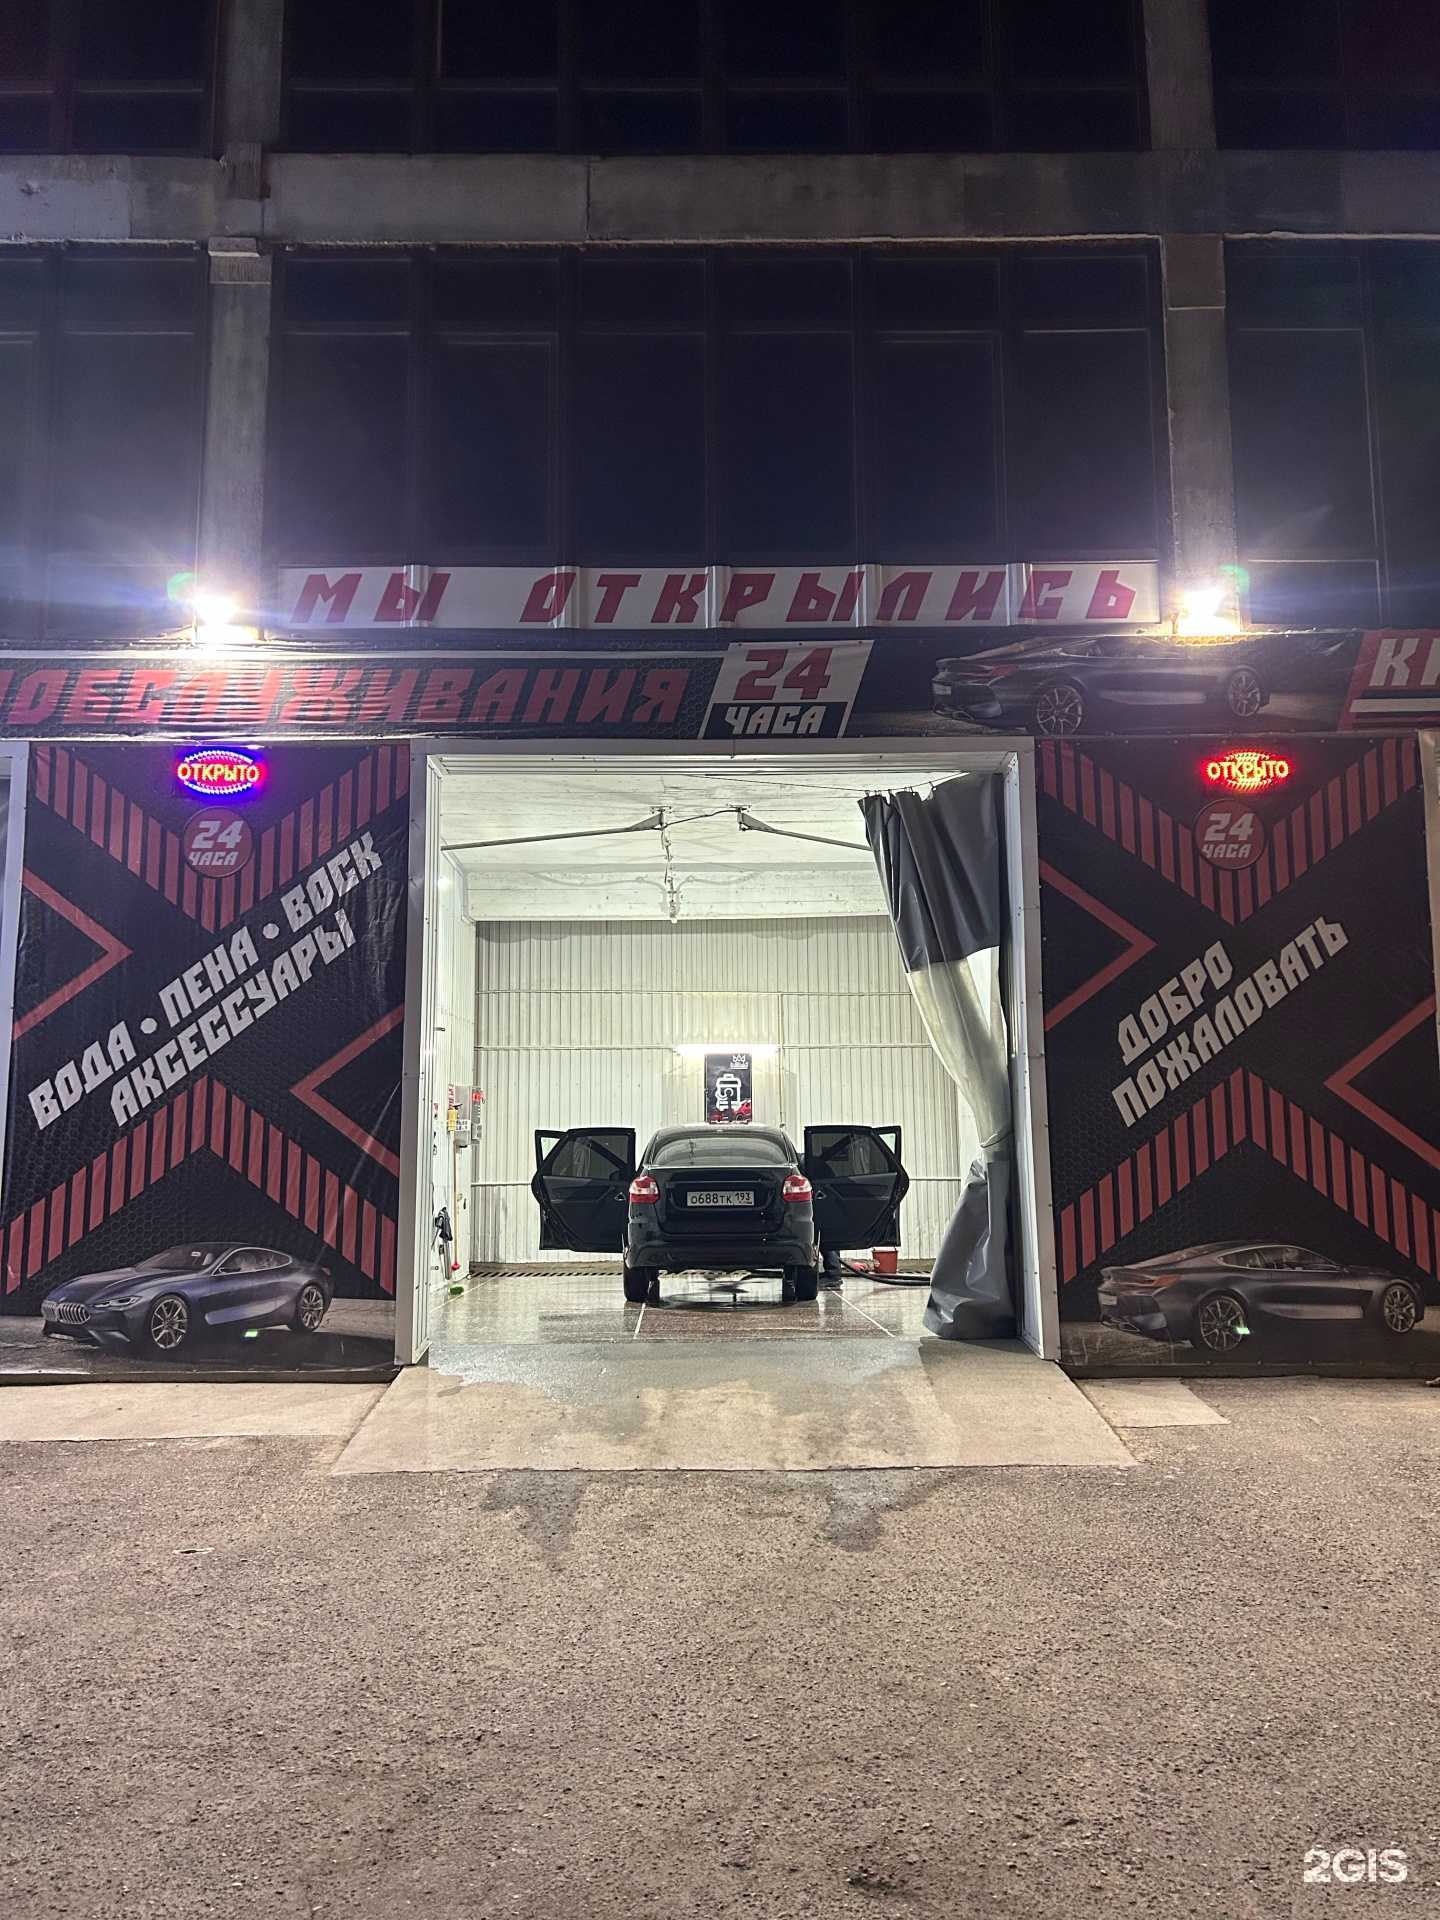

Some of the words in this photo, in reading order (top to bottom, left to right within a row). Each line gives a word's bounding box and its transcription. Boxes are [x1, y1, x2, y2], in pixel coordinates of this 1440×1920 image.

[291, 573, 451, 623] МЫ
[519, 570, 1136, 623] ОТКРЫЛИСЬ
[733, 648, 833, 700] 24
[0, 667, 690, 725] ОБСЛУЖИВАНИЯ
[725, 706, 827, 735] ЧАСА
[177, 763, 261, 782] ОТКРЫТО
[1207, 760, 1290, 780] ОТКРЫТО
[192, 820, 244, 848] 24
[1205, 813, 1255, 841] 24
[188, 852, 239, 865] ЧАСА
[1202, 844, 1252, 858] ЧАСА
[27, 1021, 136, 1130] ВОДА
[158, 926, 259, 1026] ПЕНА
[280, 832, 384, 933] ВОСК
[110, 909, 357, 1127] АКСЕССУАРЫ
[1112, 916, 1349, 1128] ПОЖАЛОВАТЬ
[1117, 940, 1233, 1065] ДОБРО
